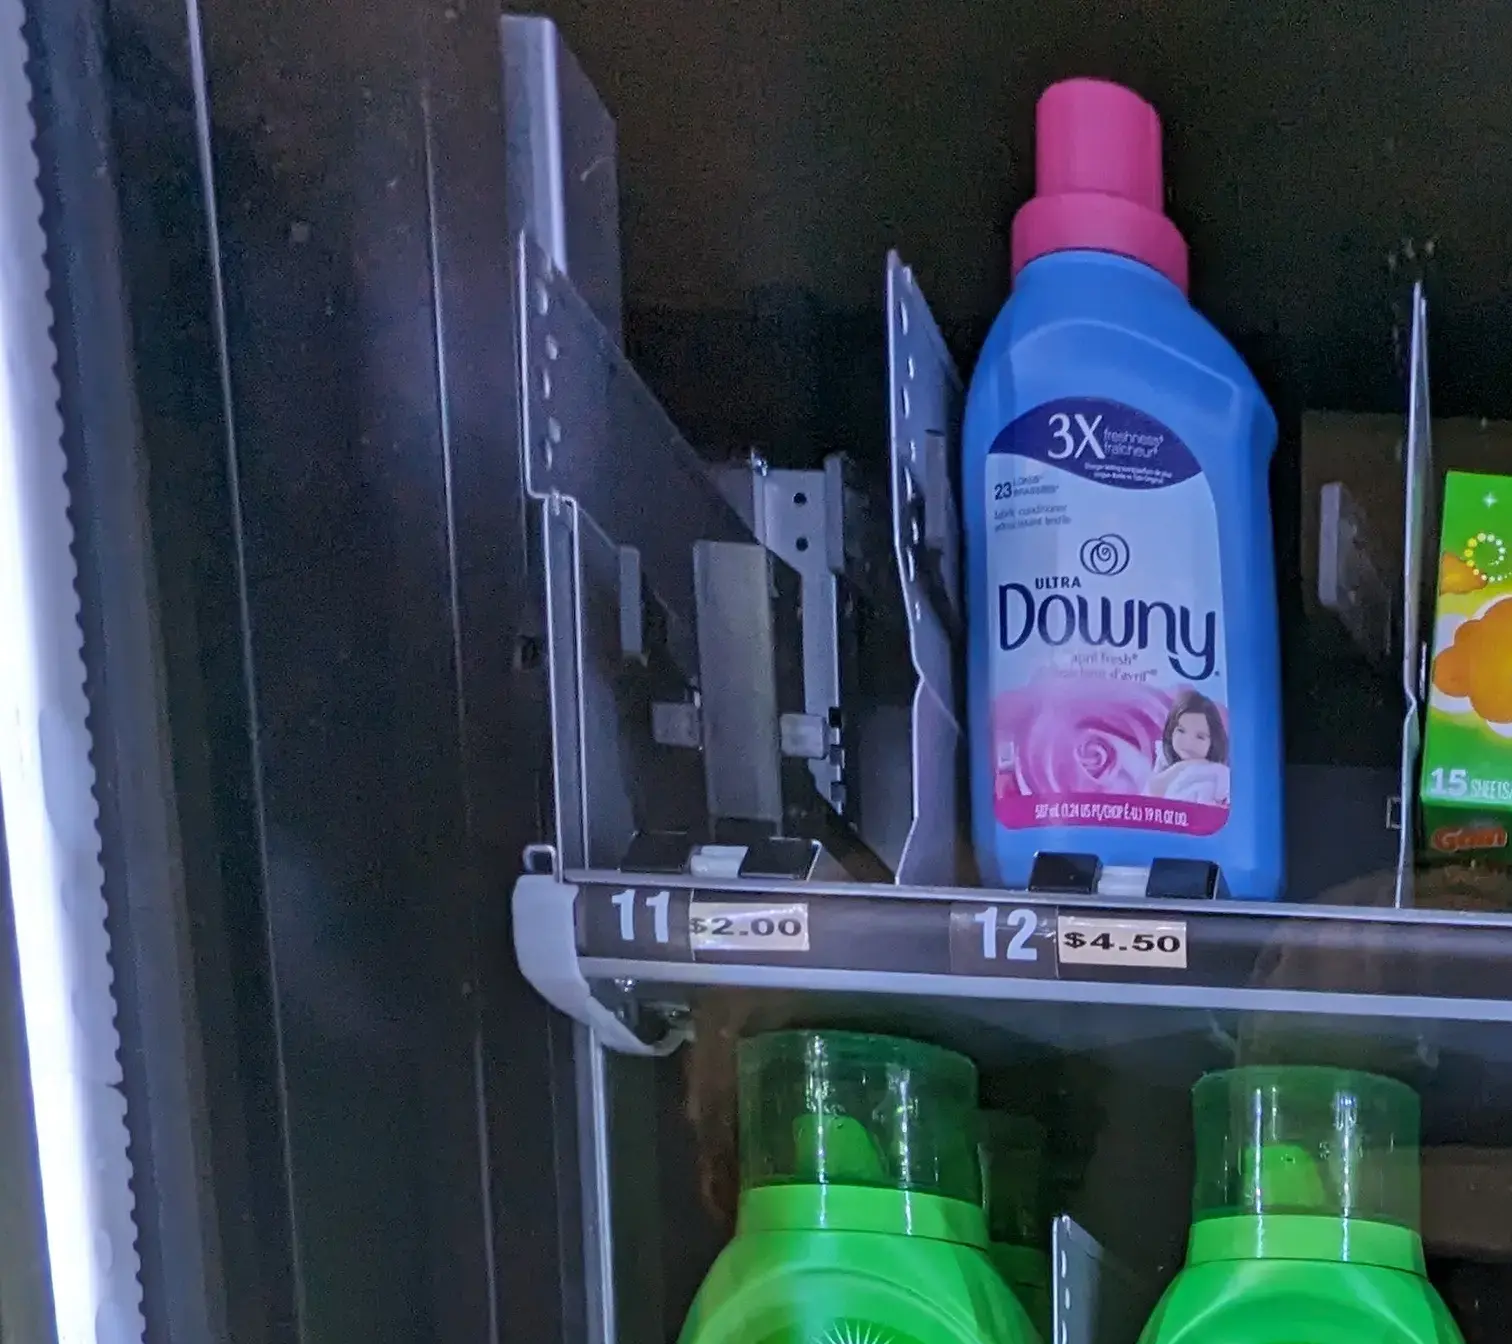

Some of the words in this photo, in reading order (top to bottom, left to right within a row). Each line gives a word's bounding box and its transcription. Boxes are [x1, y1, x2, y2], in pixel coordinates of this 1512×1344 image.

[1047, 413, 1105, 460] 3X
[995, 483, 1012, 499] 23
[1035, 576, 1081, 589] ULTRA
[999, 583, 1216, 680] Downy
[1431, 769, 1468, 796] 15
[612, 889, 670, 944] 11
[689, 916, 802, 938] $2.00
[974, 907, 1039, 961] 12
[1063, 930, 1181, 955] $4.50
